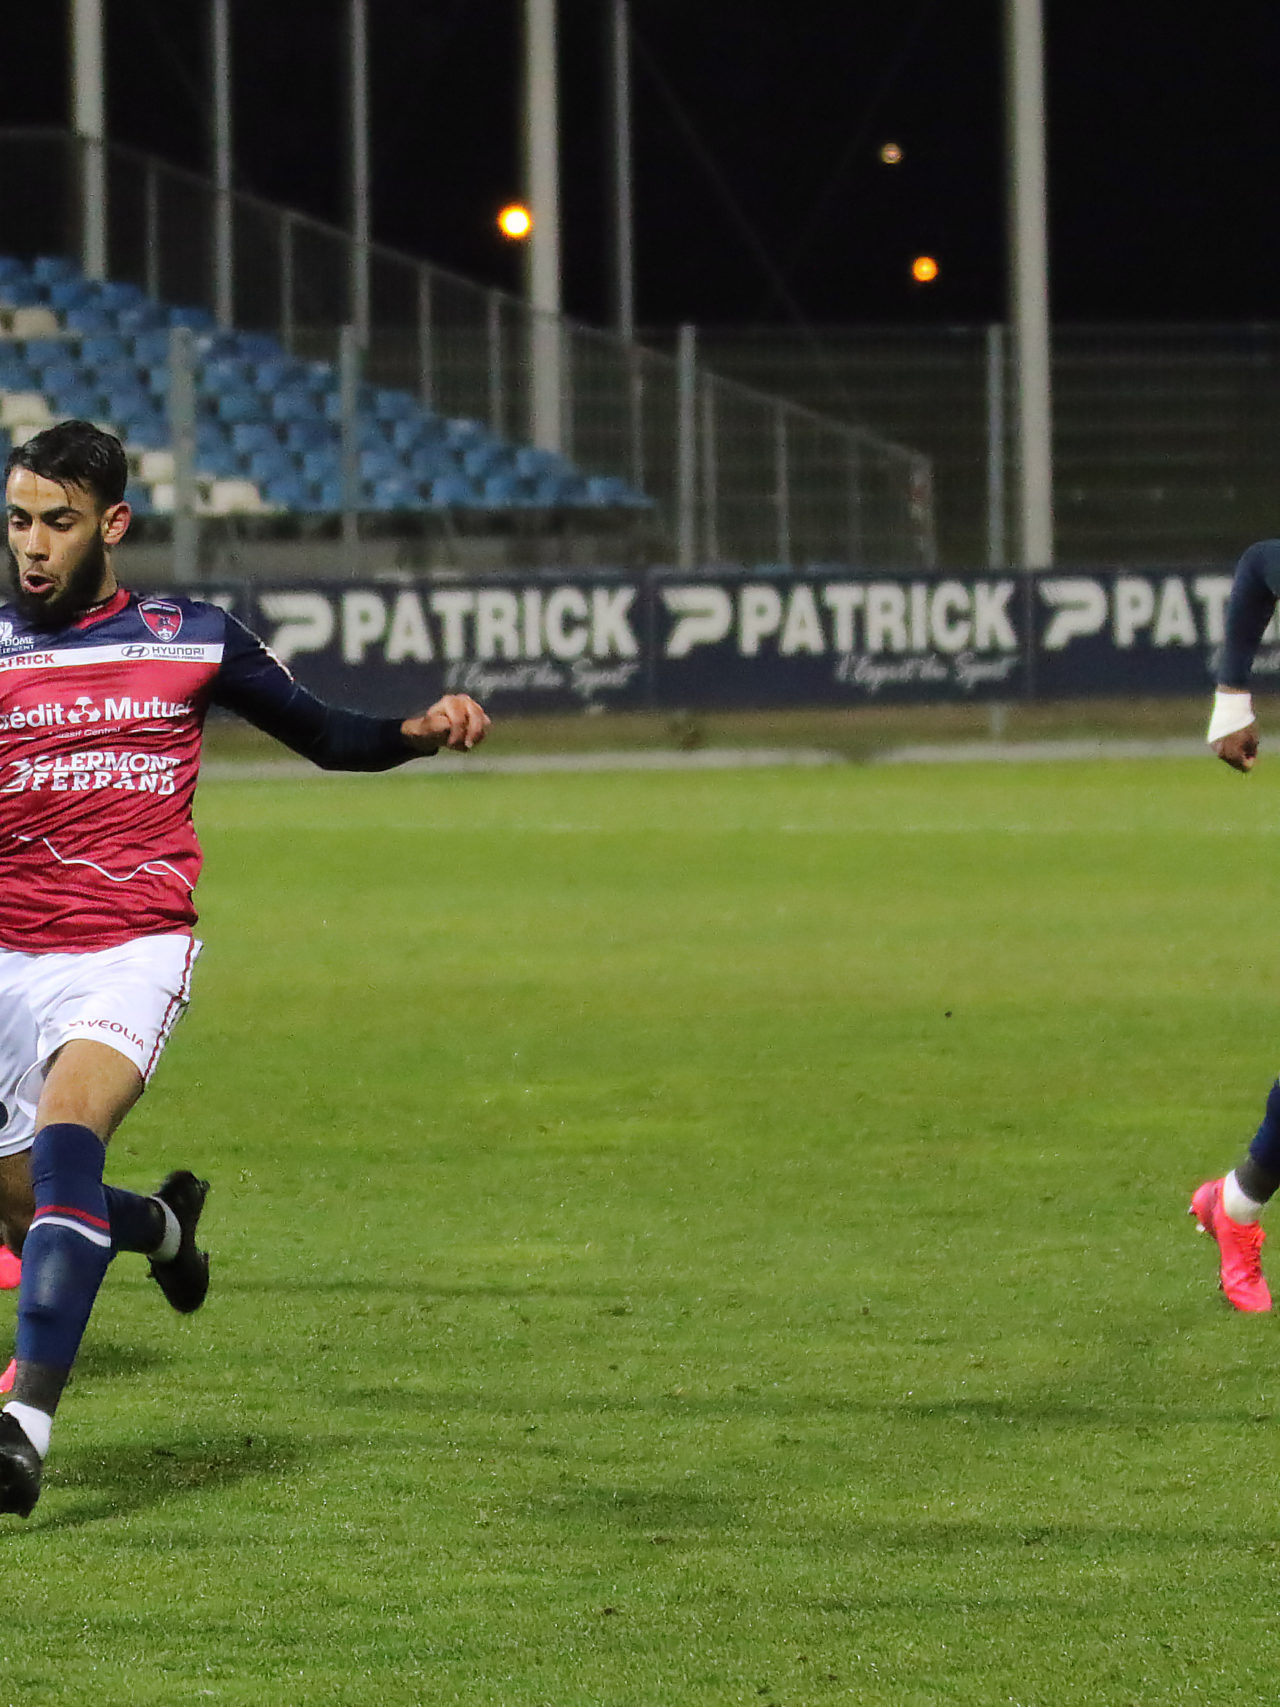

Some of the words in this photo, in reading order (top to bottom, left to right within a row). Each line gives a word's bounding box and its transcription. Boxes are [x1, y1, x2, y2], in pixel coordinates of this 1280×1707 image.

[341, 585, 639, 664] PATRICK
[739, 581, 1018, 656] PATRICK
[152, 646, 205, 656] HYUNDAI
[34, 752, 181, 776] CLERMONT
[31, 771, 176, 795] FERRAND
[88, 1019, 144, 1051] VEOLIA
